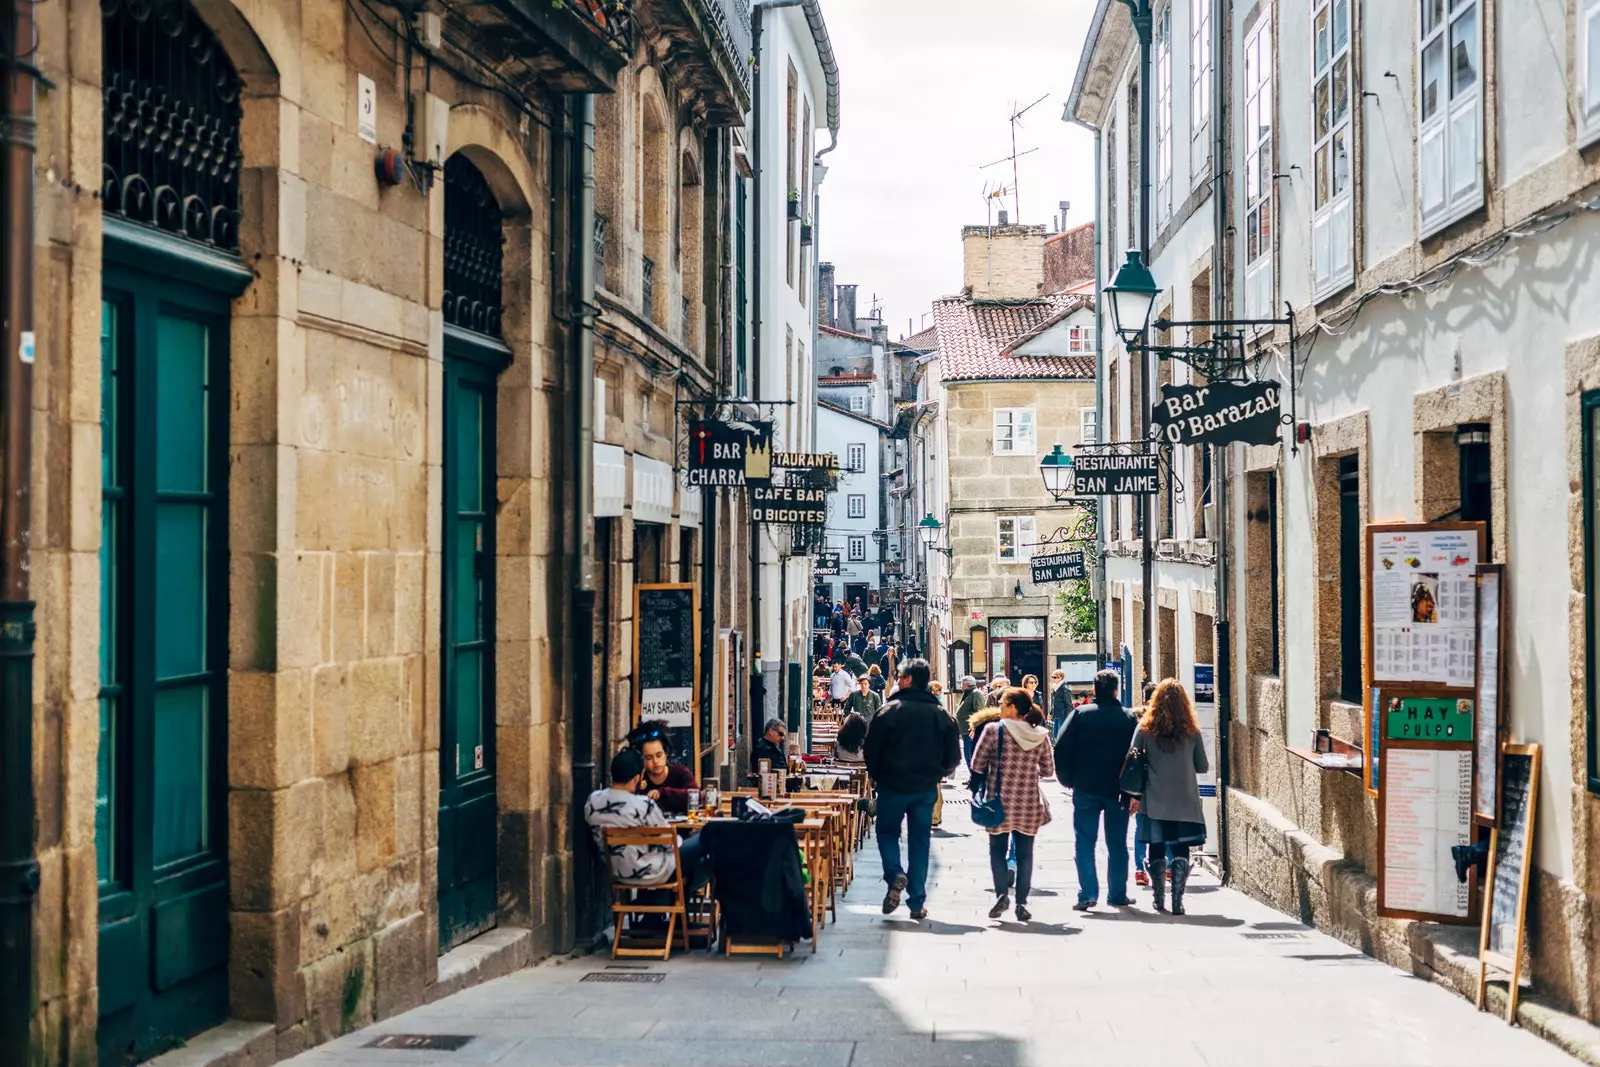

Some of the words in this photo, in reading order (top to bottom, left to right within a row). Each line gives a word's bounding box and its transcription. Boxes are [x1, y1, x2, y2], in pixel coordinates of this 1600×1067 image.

[1165, 388, 1209, 418] Bar
[713, 442, 741, 459] BAR
[1075, 456, 1157, 470] RESTAURANTE
[689, 468, 746, 485] CHARRA
[1076, 477, 1106, 492] SAN
[1114, 475, 1157, 492] JAIME
[754, 487, 793, 500] CAFE
[796, 489, 824, 502] BAR
[1031, 553, 1082, 568] RESTAURANTE
[1034, 569, 1053, 581] SAN
[1056, 565, 1082, 579] JAIME
[642, 701, 656, 715] HAY
[656, 700, 690, 714] SARDINAS
[1408, 706, 1448, 720] HAY
[1403, 723, 1454, 737] PULPO
